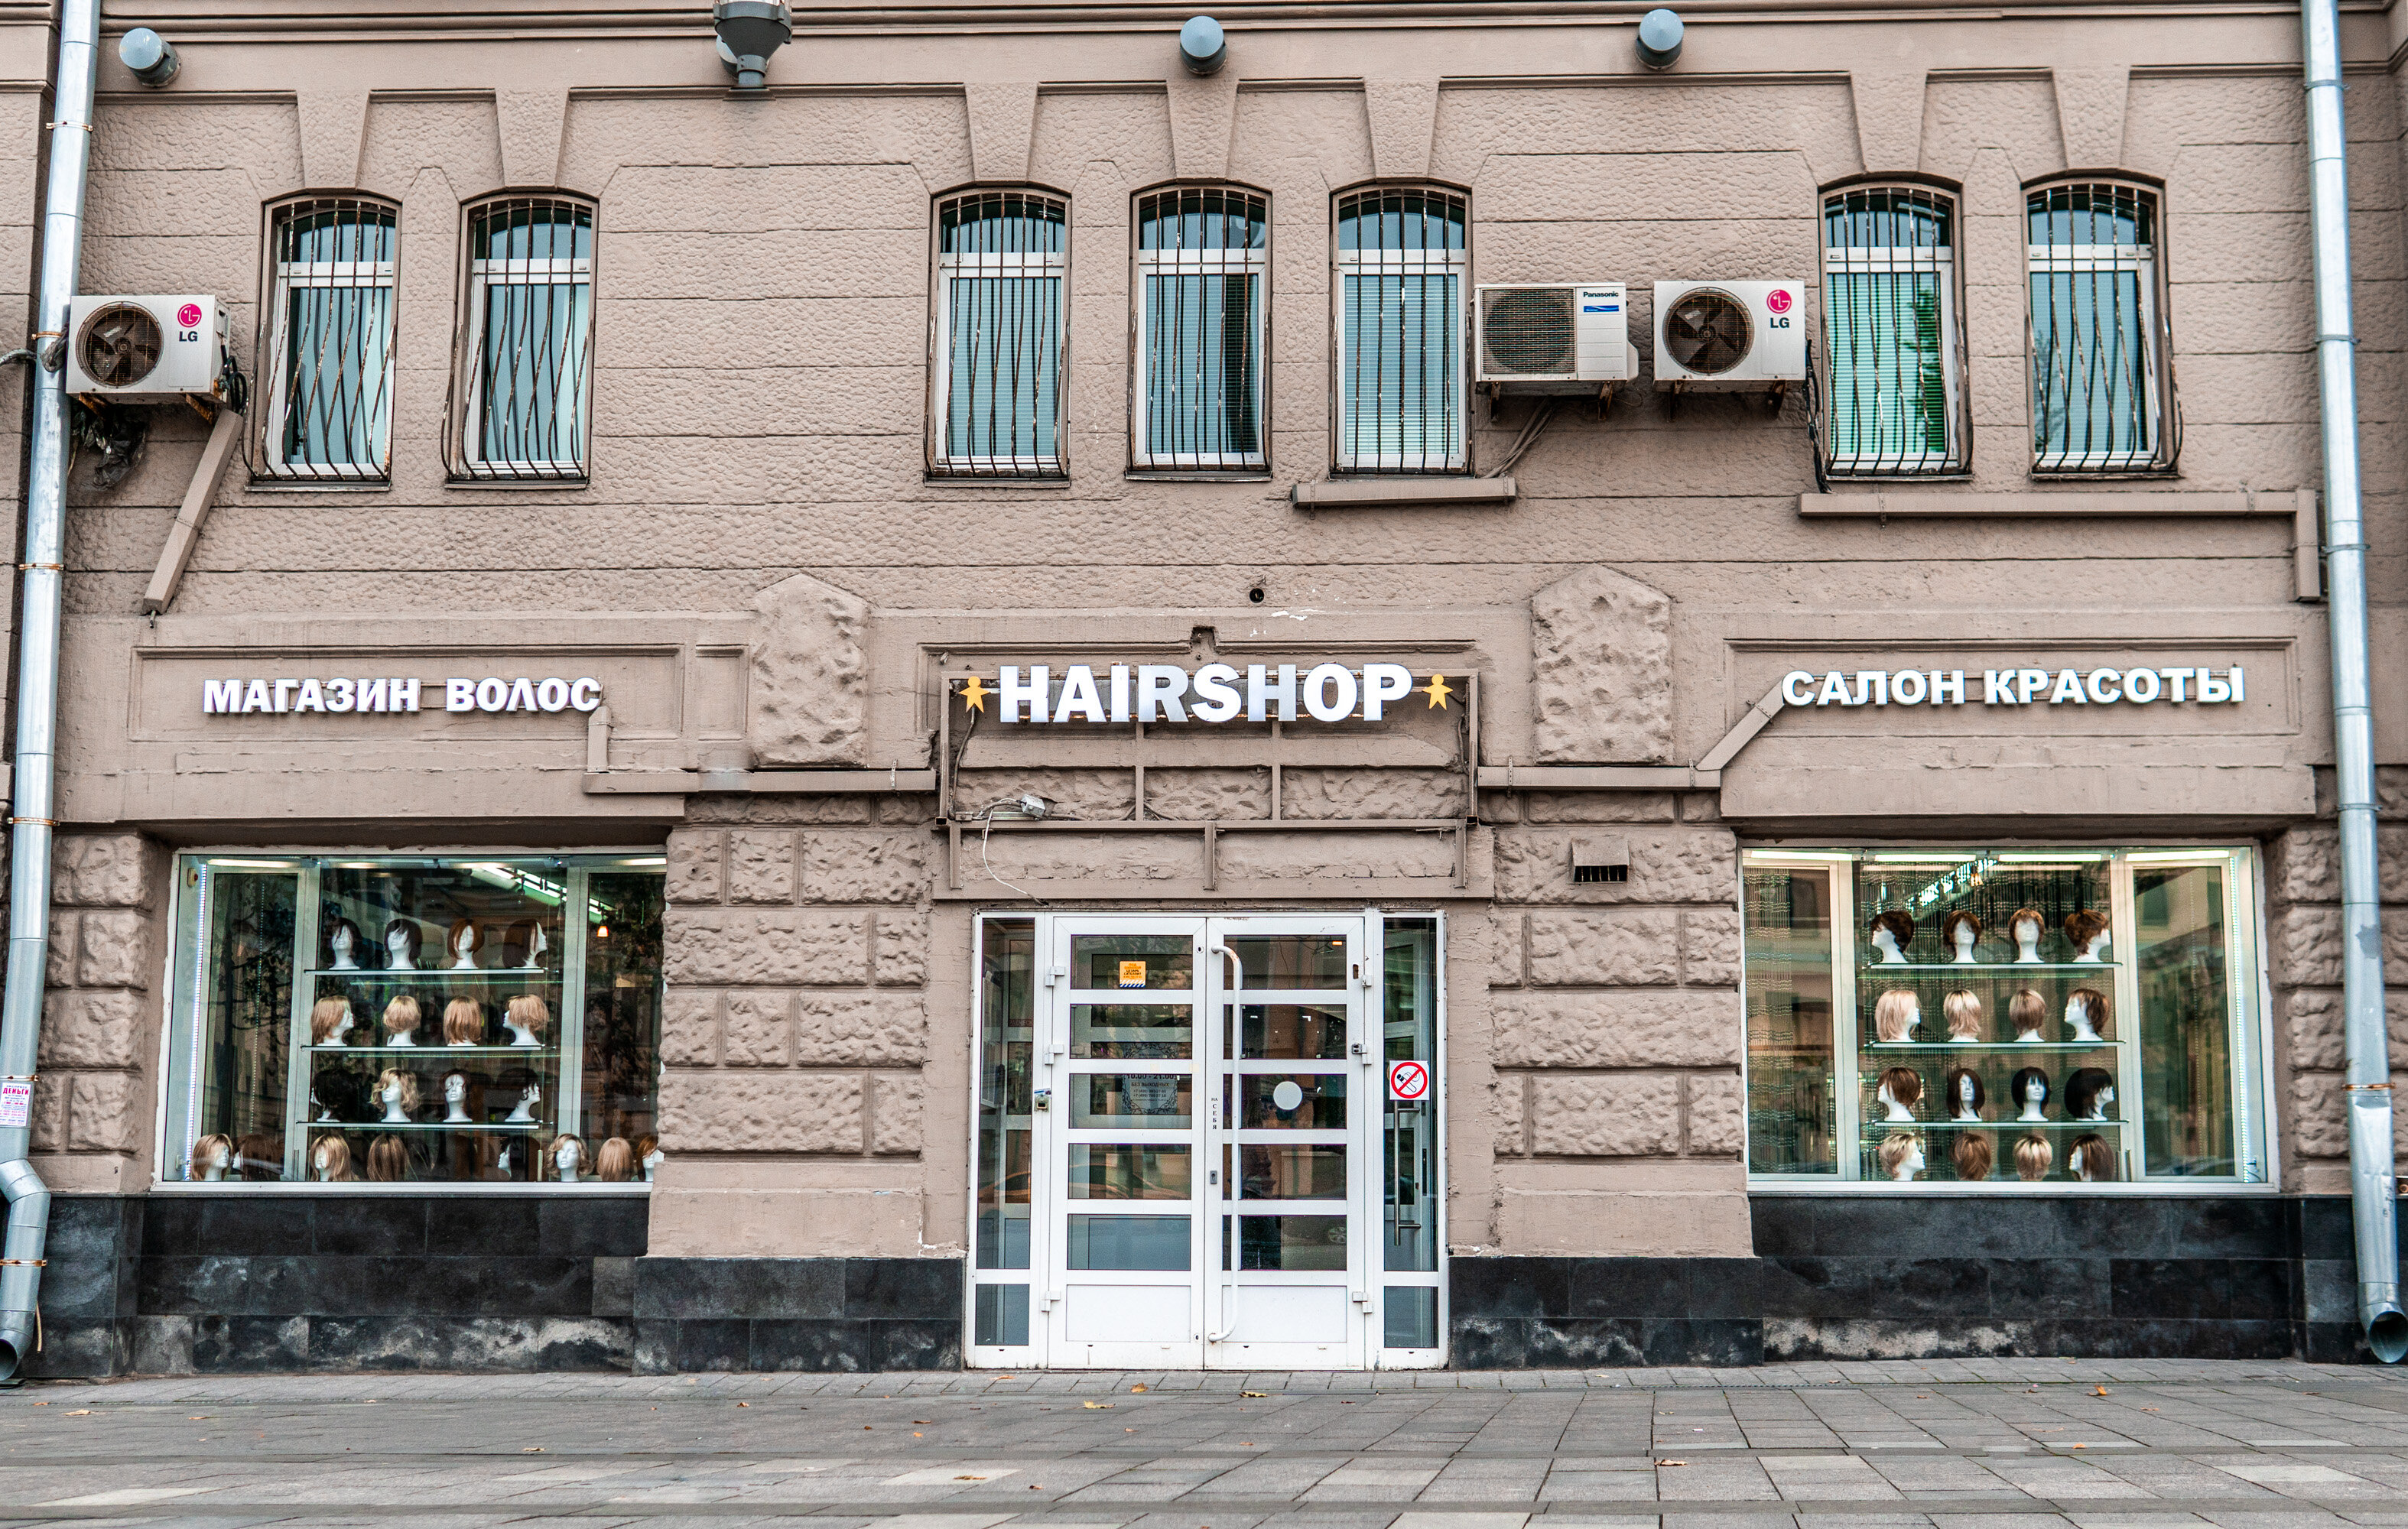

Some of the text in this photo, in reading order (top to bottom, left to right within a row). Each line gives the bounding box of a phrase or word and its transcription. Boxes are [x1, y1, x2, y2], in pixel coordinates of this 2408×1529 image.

[179, 331, 198, 342] LG
[1770, 317, 1790, 329] LG
[203, 677, 602, 714] МАГАЗИН ВОЛОС
[999, 663, 1412, 723] HAIRSHOP
[1782, 667, 2245, 706] САЛОН КРАСОТЫ
